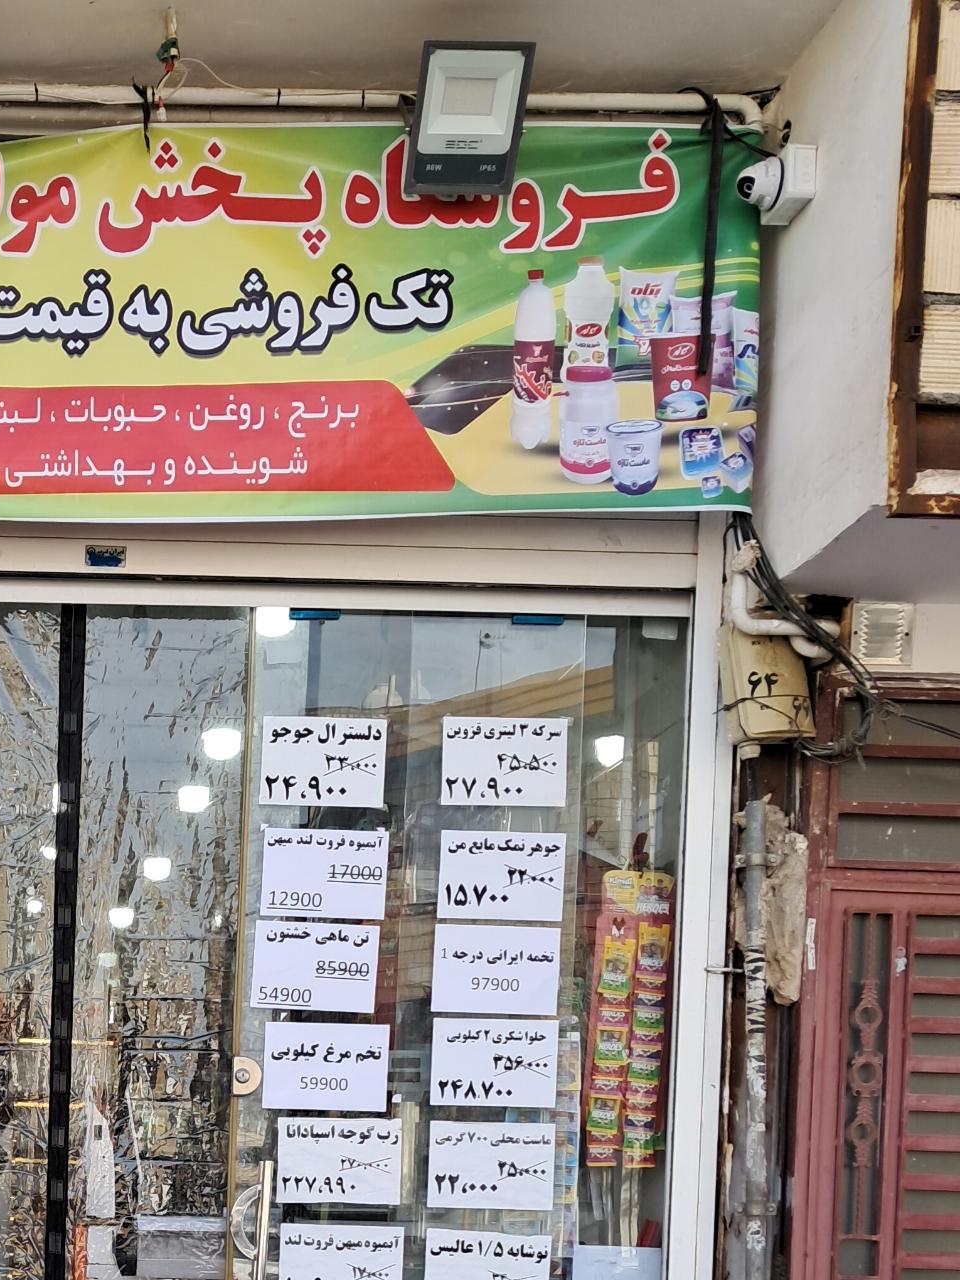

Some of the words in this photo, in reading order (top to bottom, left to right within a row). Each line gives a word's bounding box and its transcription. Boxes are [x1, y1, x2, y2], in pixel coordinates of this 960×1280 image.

[96, 138, 326, 257] پخش
[341, 129, 682, 254] فرواه
[368, 267, 454, 332] تک
[118, 281, 172, 357] به
[176, 264, 360, 358] فروشی
[64, 395, 167, 432] حبوبات
[189, 394, 266, 431] روغن
[288, 395, 360, 438] برنج
[4, 449, 156, 488] بهداشتی
[164, 461, 177, 485] و
[184, 447, 309, 485] شوینده
[747, 671, 778, 697] ۶۴
[268, 726, 315, 745] جوجو
[338, 723, 383, 746] دلستر
[446, 722, 482, 740] قزوین
[483, 723, 517, 741] لیتری
[518, 723, 529, 737] ۳
[531, 724, 562, 742] سرکه
[266, 835, 294, 848] میهن
[296, 833, 314, 846] لند
[317, 834, 346, 849] فروت
[348, 835, 385, 852] آبمیوه
[467, 838, 496, 855] مایع
[496, 839, 526, 853] نمک
[527, 842, 562, 858] جوهر
[327, 863, 383, 882] 17000
[266, 890, 323, 910] 12900
[266, 926, 312, 944] خشتون
[314, 928, 350, 946] ماهی
[352, 931, 370, 948] تن
[451, 949, 484, 964] درجه
[486, 948, 524, 966] ایرانی
[526, 950, 555, 964] تخمه
[314, 959, 370, 978] 85900
[471, 976, 520, 993] 97900
[256, 985, 312, 1004] 54900
[446, 1029, 483, 1044] کیلویی
[491, 1030, 524, 1045] شکری
[270, 1042, 320, 1062] کیلویی
[322, 1042, 352, 1064] مرغ
[355, 1045, 383, 1065] تخم
[299, 1076, 349, 1092] 59900
[286, 1123, 336, 1145] اسپادانا
[337, 1125, 375, 1144] گوجه
[376, 1128, 401, 1146] رب
[467, 1131, 488, 1144] ۷۰۰
[489, 1132, 521, 1148] محلی
[522, 1134, 552, 1146] ماست
[284, 1233, 302, 1246] لند
[303, 1233, 335, 1251] فروت
[334, 1239, 363, 1252] میهن
[429, 1238, 474, 1257] عالیس
[506, 1243, 549, 1265] نوشابه
